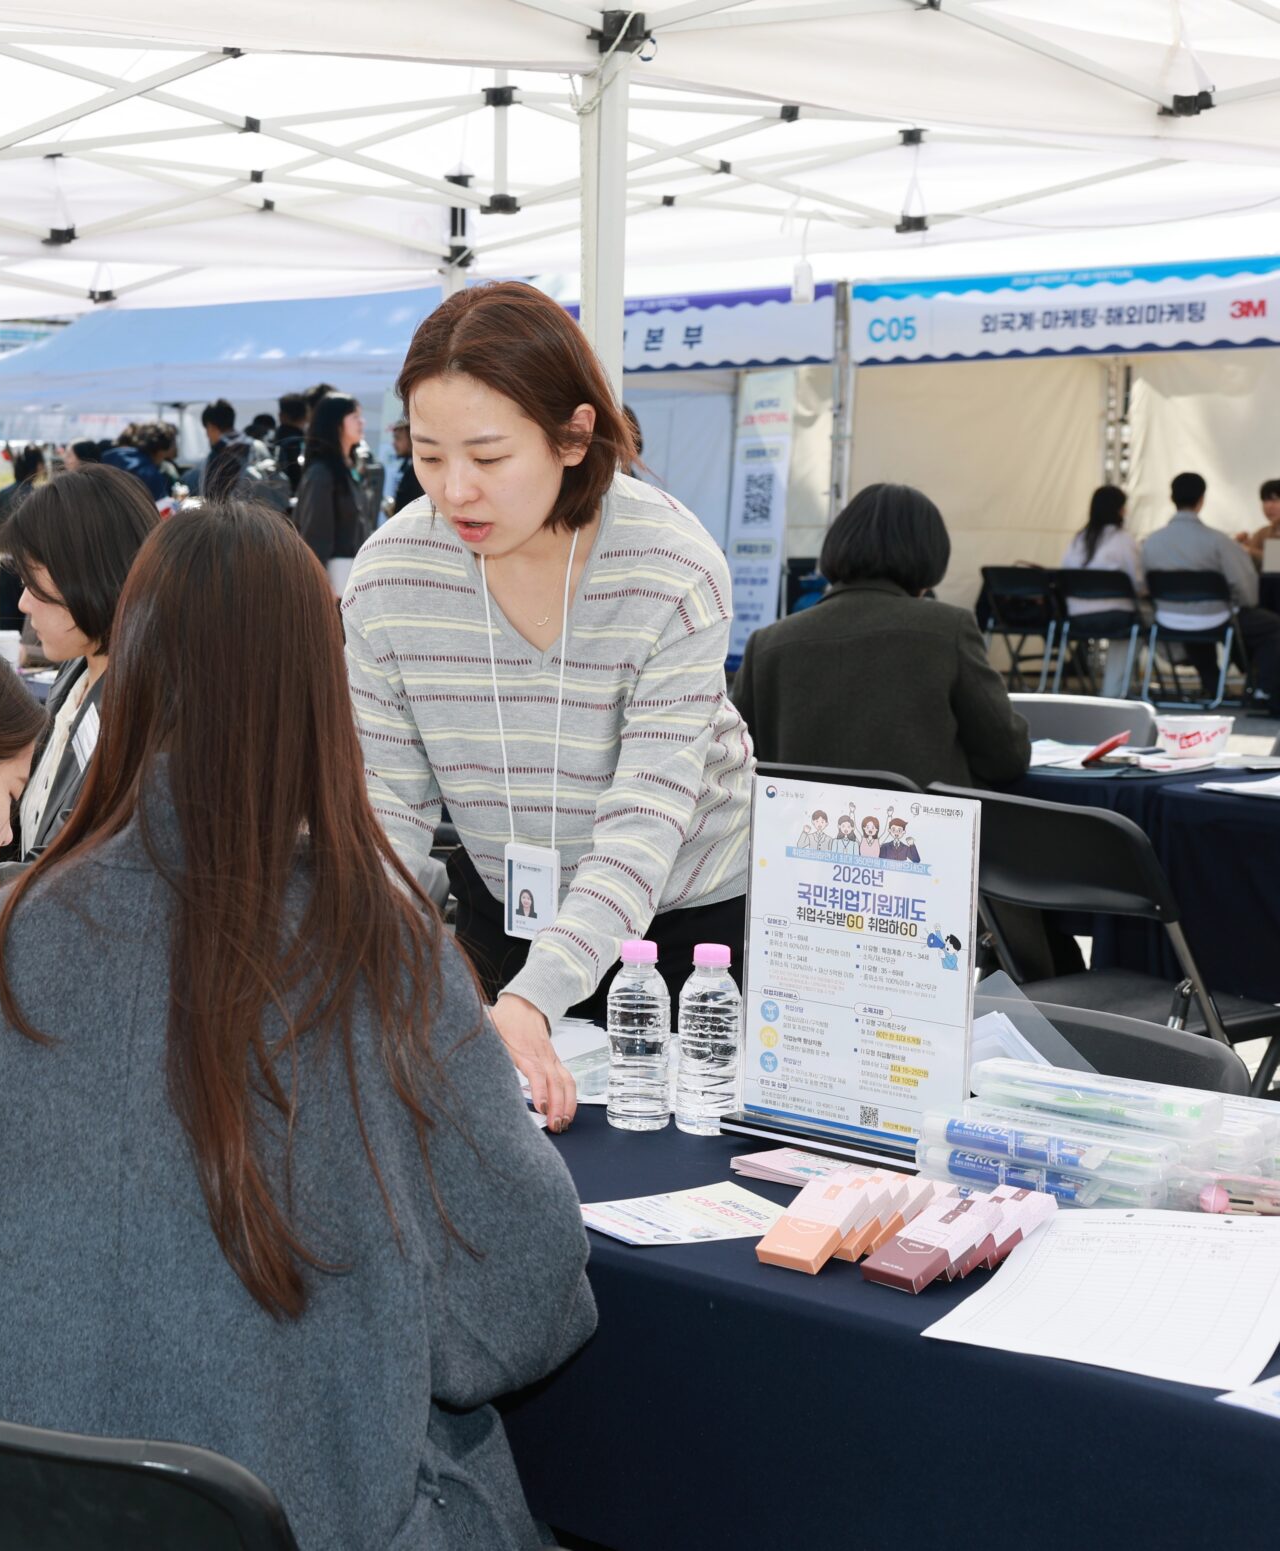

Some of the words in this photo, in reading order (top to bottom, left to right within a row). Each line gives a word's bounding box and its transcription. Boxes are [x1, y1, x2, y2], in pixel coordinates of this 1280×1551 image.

[980, 300, 1206, 334] 외국계·마케팅·해외마케팅
[1230, 299, 1267, 319] 3M
[869, 317, 916, 342] C05
[833, 864, 884, 888] 2026년
[797, 882, 927, 922] 국민취업지원제도
[796, 906, 864, 930] 취업수당받GO
[868, 917, 918, 938] 취업하GO
[956, 1150, 1002, 1167] PERIO
[713, 1206, 768, 1230] FESTIVAL
